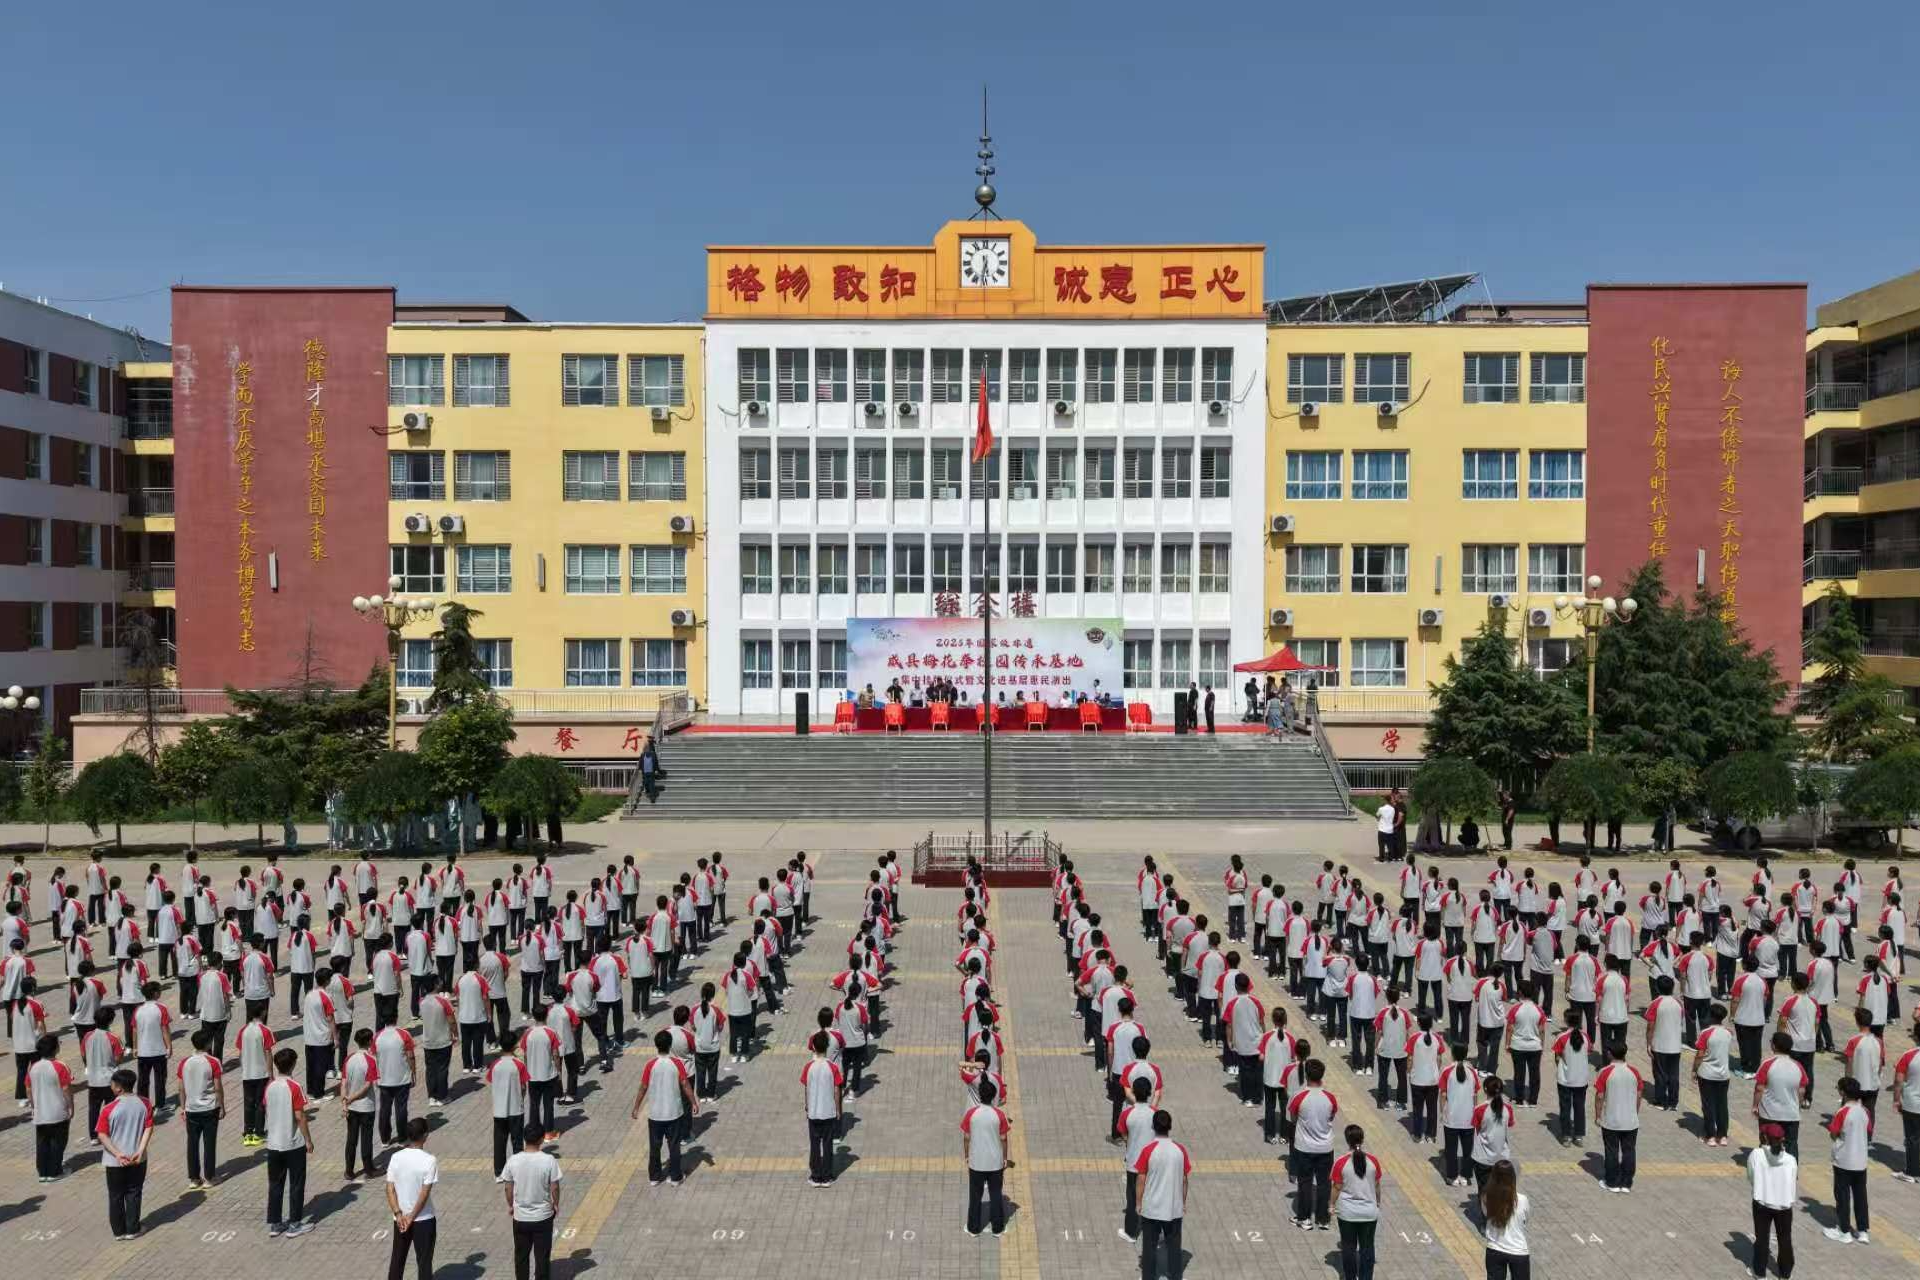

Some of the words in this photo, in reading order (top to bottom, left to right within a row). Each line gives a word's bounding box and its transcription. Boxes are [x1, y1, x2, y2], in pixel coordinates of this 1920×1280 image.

[726, 264, 917, 304] 格物致知
[1053, 264, 1247, 304] 诚意正心
[1649, 336, 1675, 558] 化民兴贤肩负时代重任
[935, 590, 1037, 617] 综合楼
[554, 727, 642, 752] 餐厅
[1382, 728, 1400, 753] 学
[712, 1229, 745, 1241] 09
[886, 1229, 916, 1241] 10
[1062, 1230, 1085, 1242] 11
[1233, 1230, 1264, 1242] 12
[1399, 1231, 1432, 1244] 13
[1571, 1232, 1603, 1244] 14
